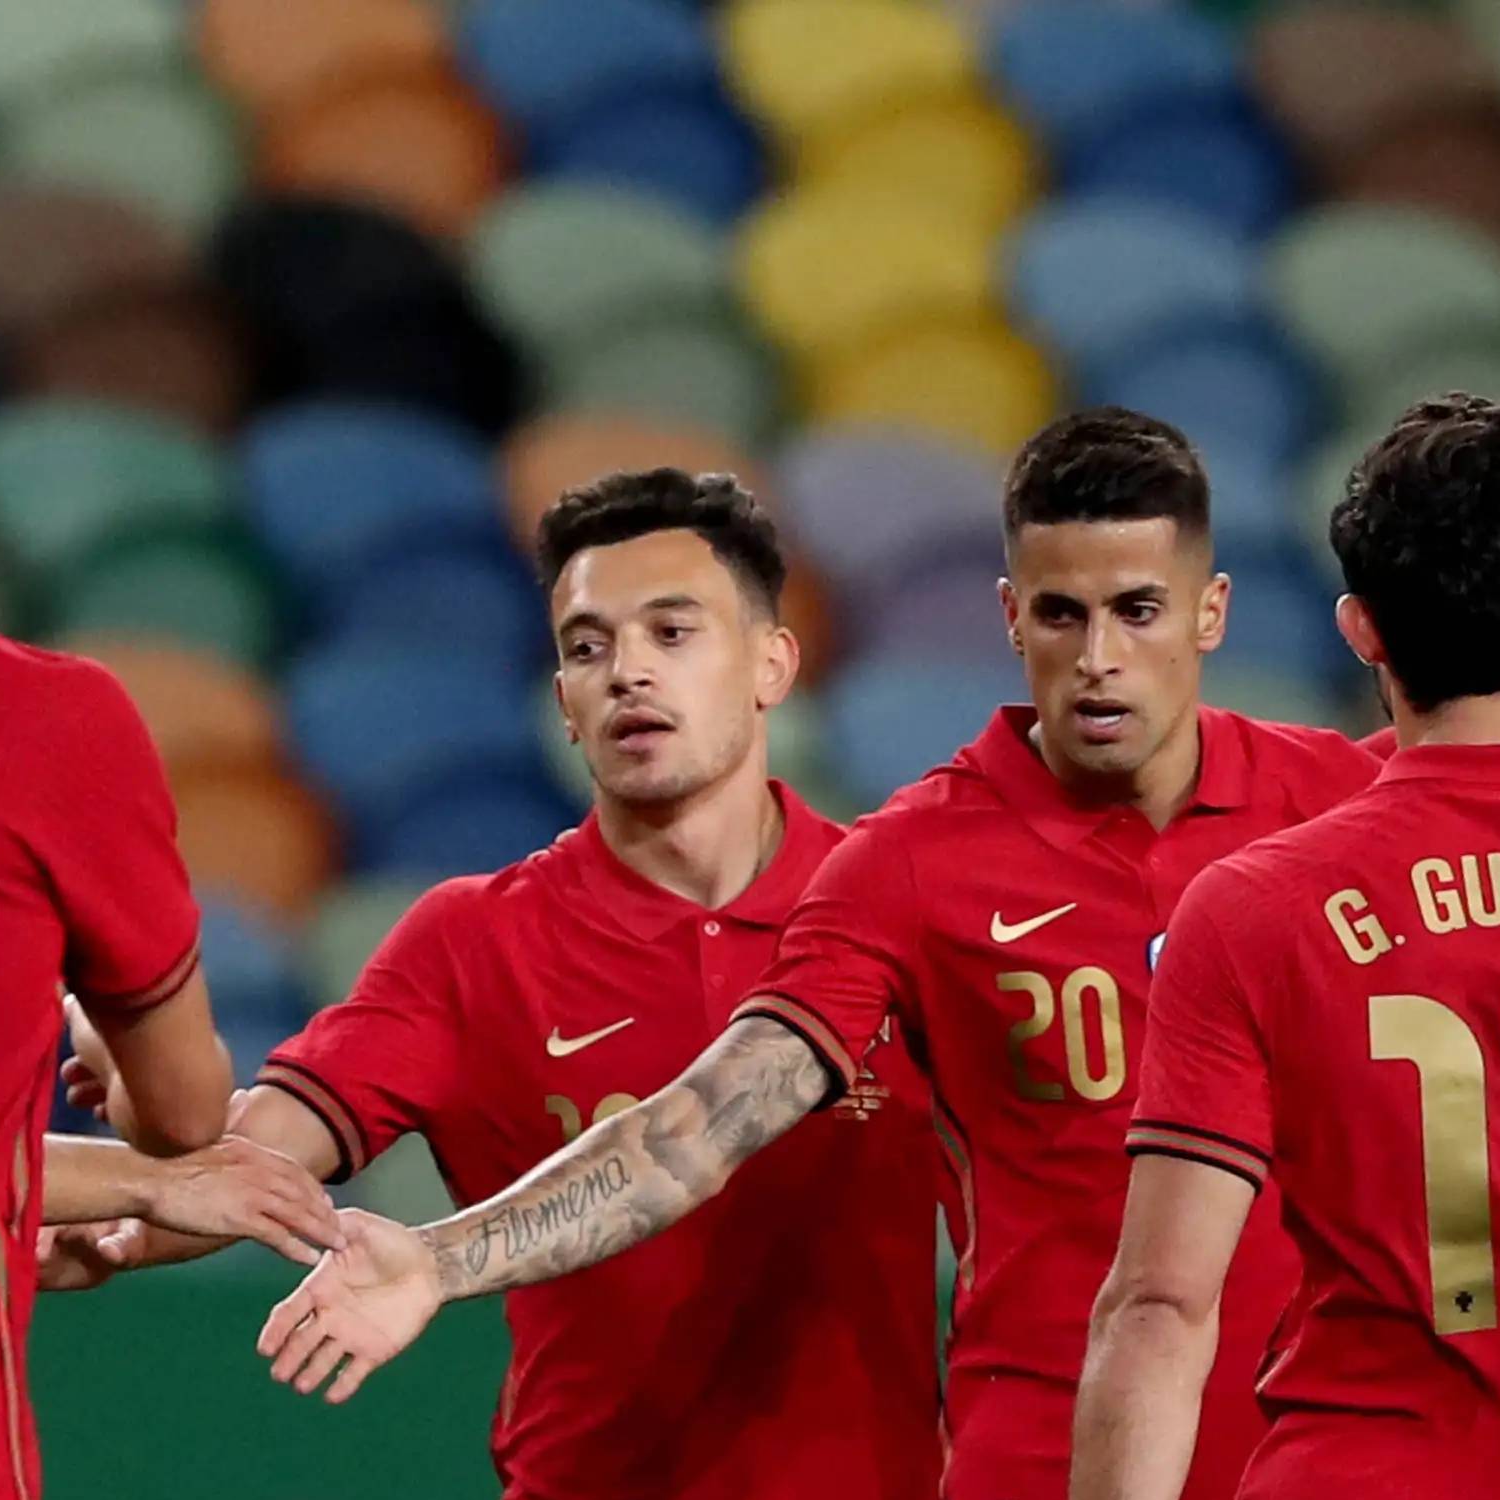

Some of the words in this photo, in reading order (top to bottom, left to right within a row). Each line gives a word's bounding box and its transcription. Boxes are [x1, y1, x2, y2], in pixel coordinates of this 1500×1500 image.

[1324, 888, 1406, 965] G.
[996, 966, 1126, 1101] 20
[466, 1155, 632, 1276] Filomena
